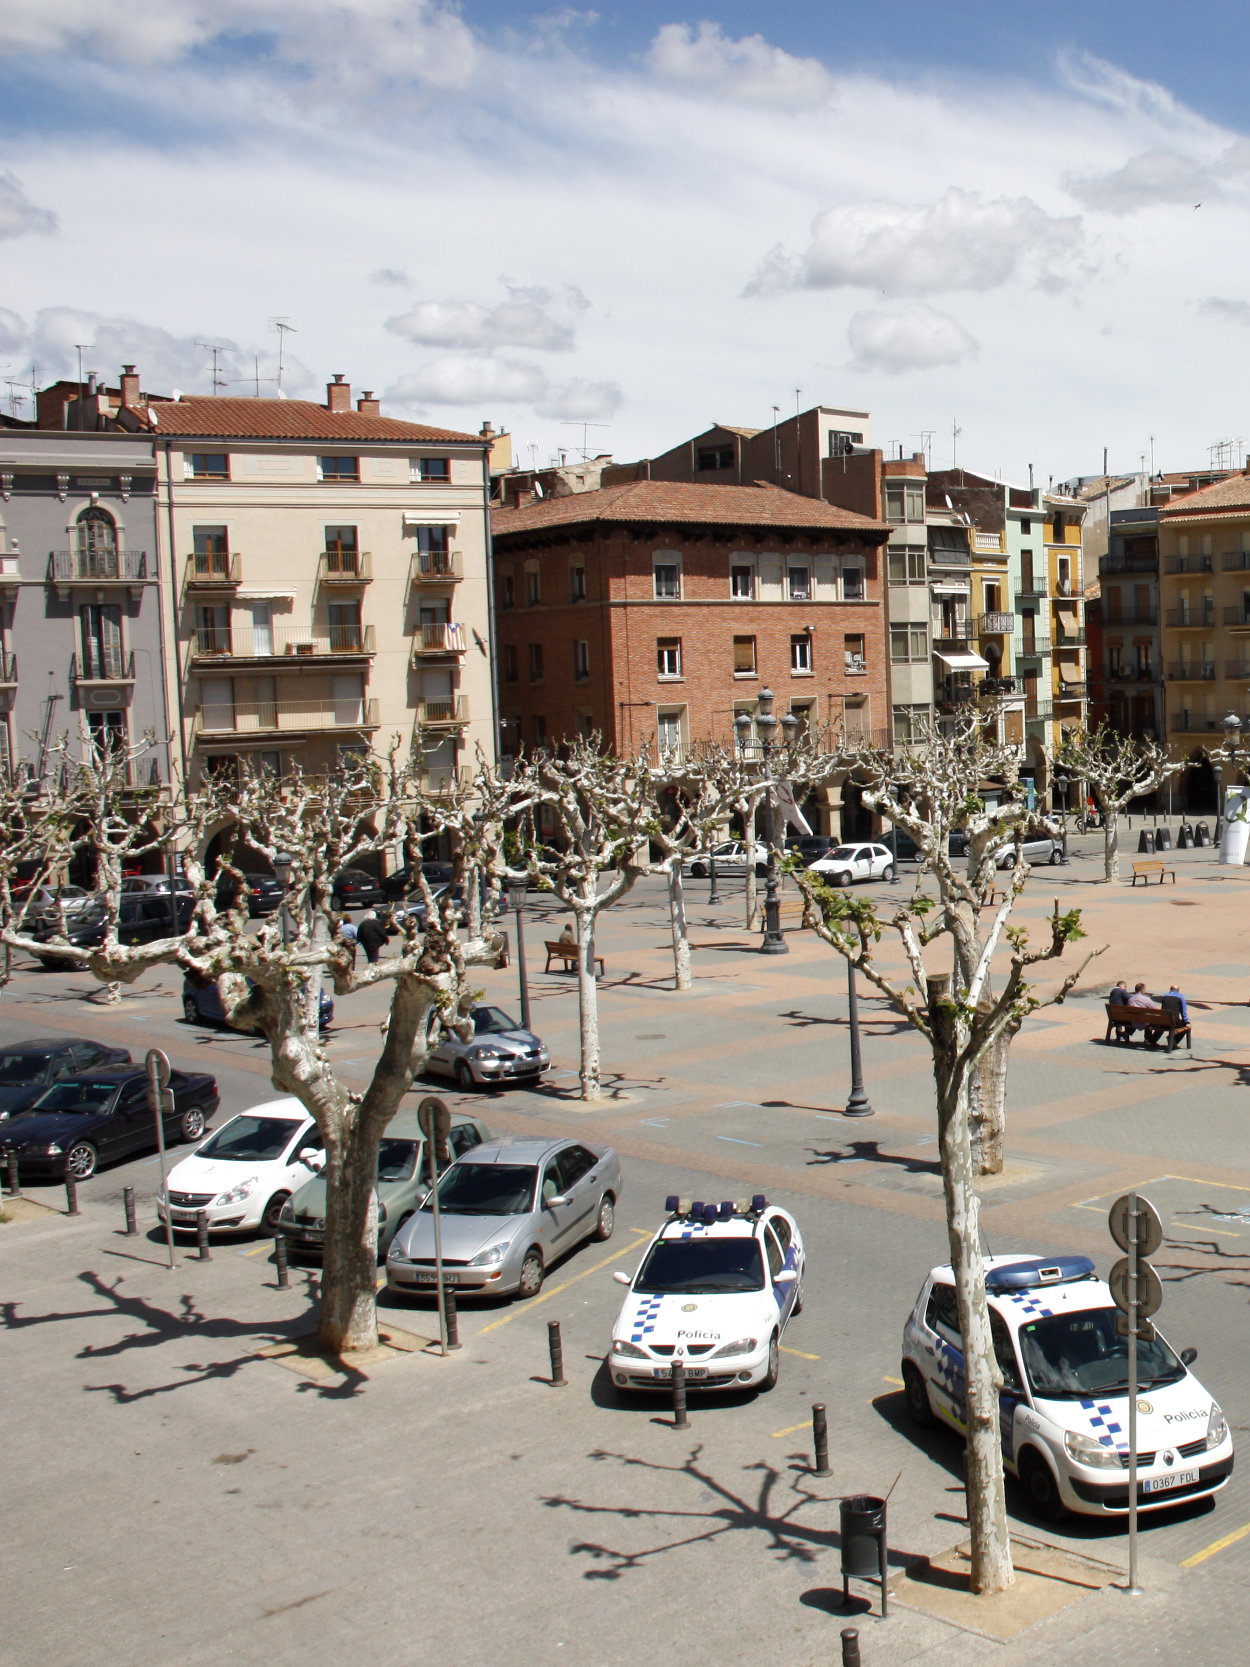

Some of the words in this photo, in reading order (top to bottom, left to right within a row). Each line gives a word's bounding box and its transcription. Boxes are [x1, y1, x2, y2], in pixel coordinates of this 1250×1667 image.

[677, 1330, 721, 1340] Policia
[688, 1369, 706, 1378] BMP
[1163, 1409, 1209, 1425] Policia
[1152, 1476, 1176, 1490] 0367
[1180, 1472, 1197, 1484] FDL
